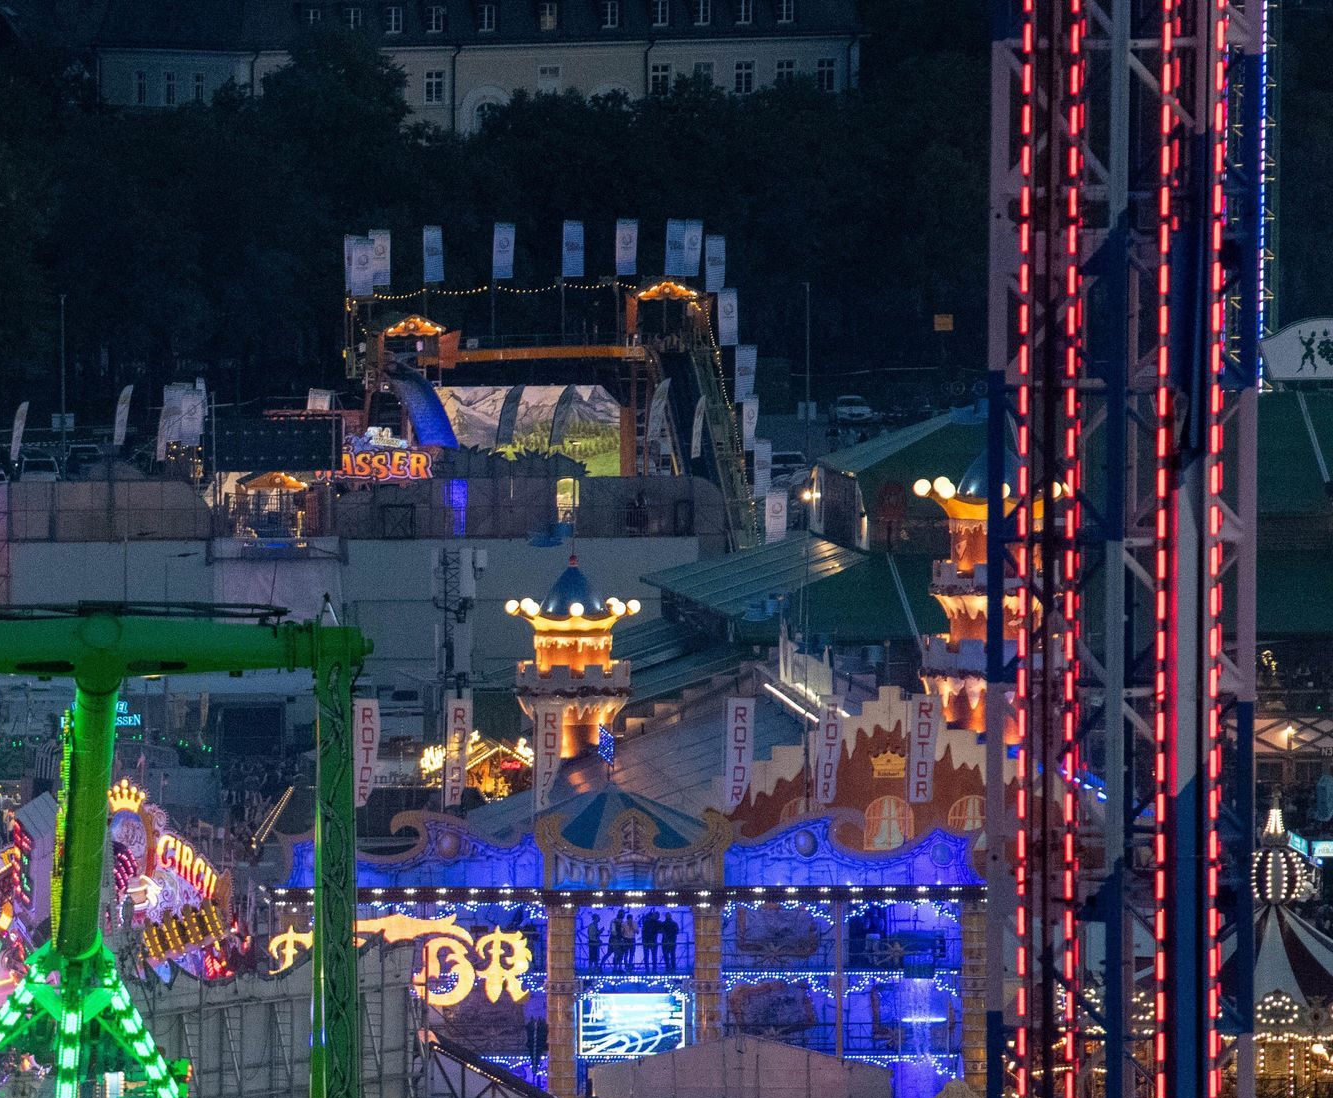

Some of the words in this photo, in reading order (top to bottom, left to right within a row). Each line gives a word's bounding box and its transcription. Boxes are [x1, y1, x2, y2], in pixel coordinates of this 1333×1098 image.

[358, 707, 374, 801] ROTOR
[450, 707, 466, 801] ROTOR
[733, 707, 747, 808] ROTOR
[916, 701, 933, 798] ROTOR
